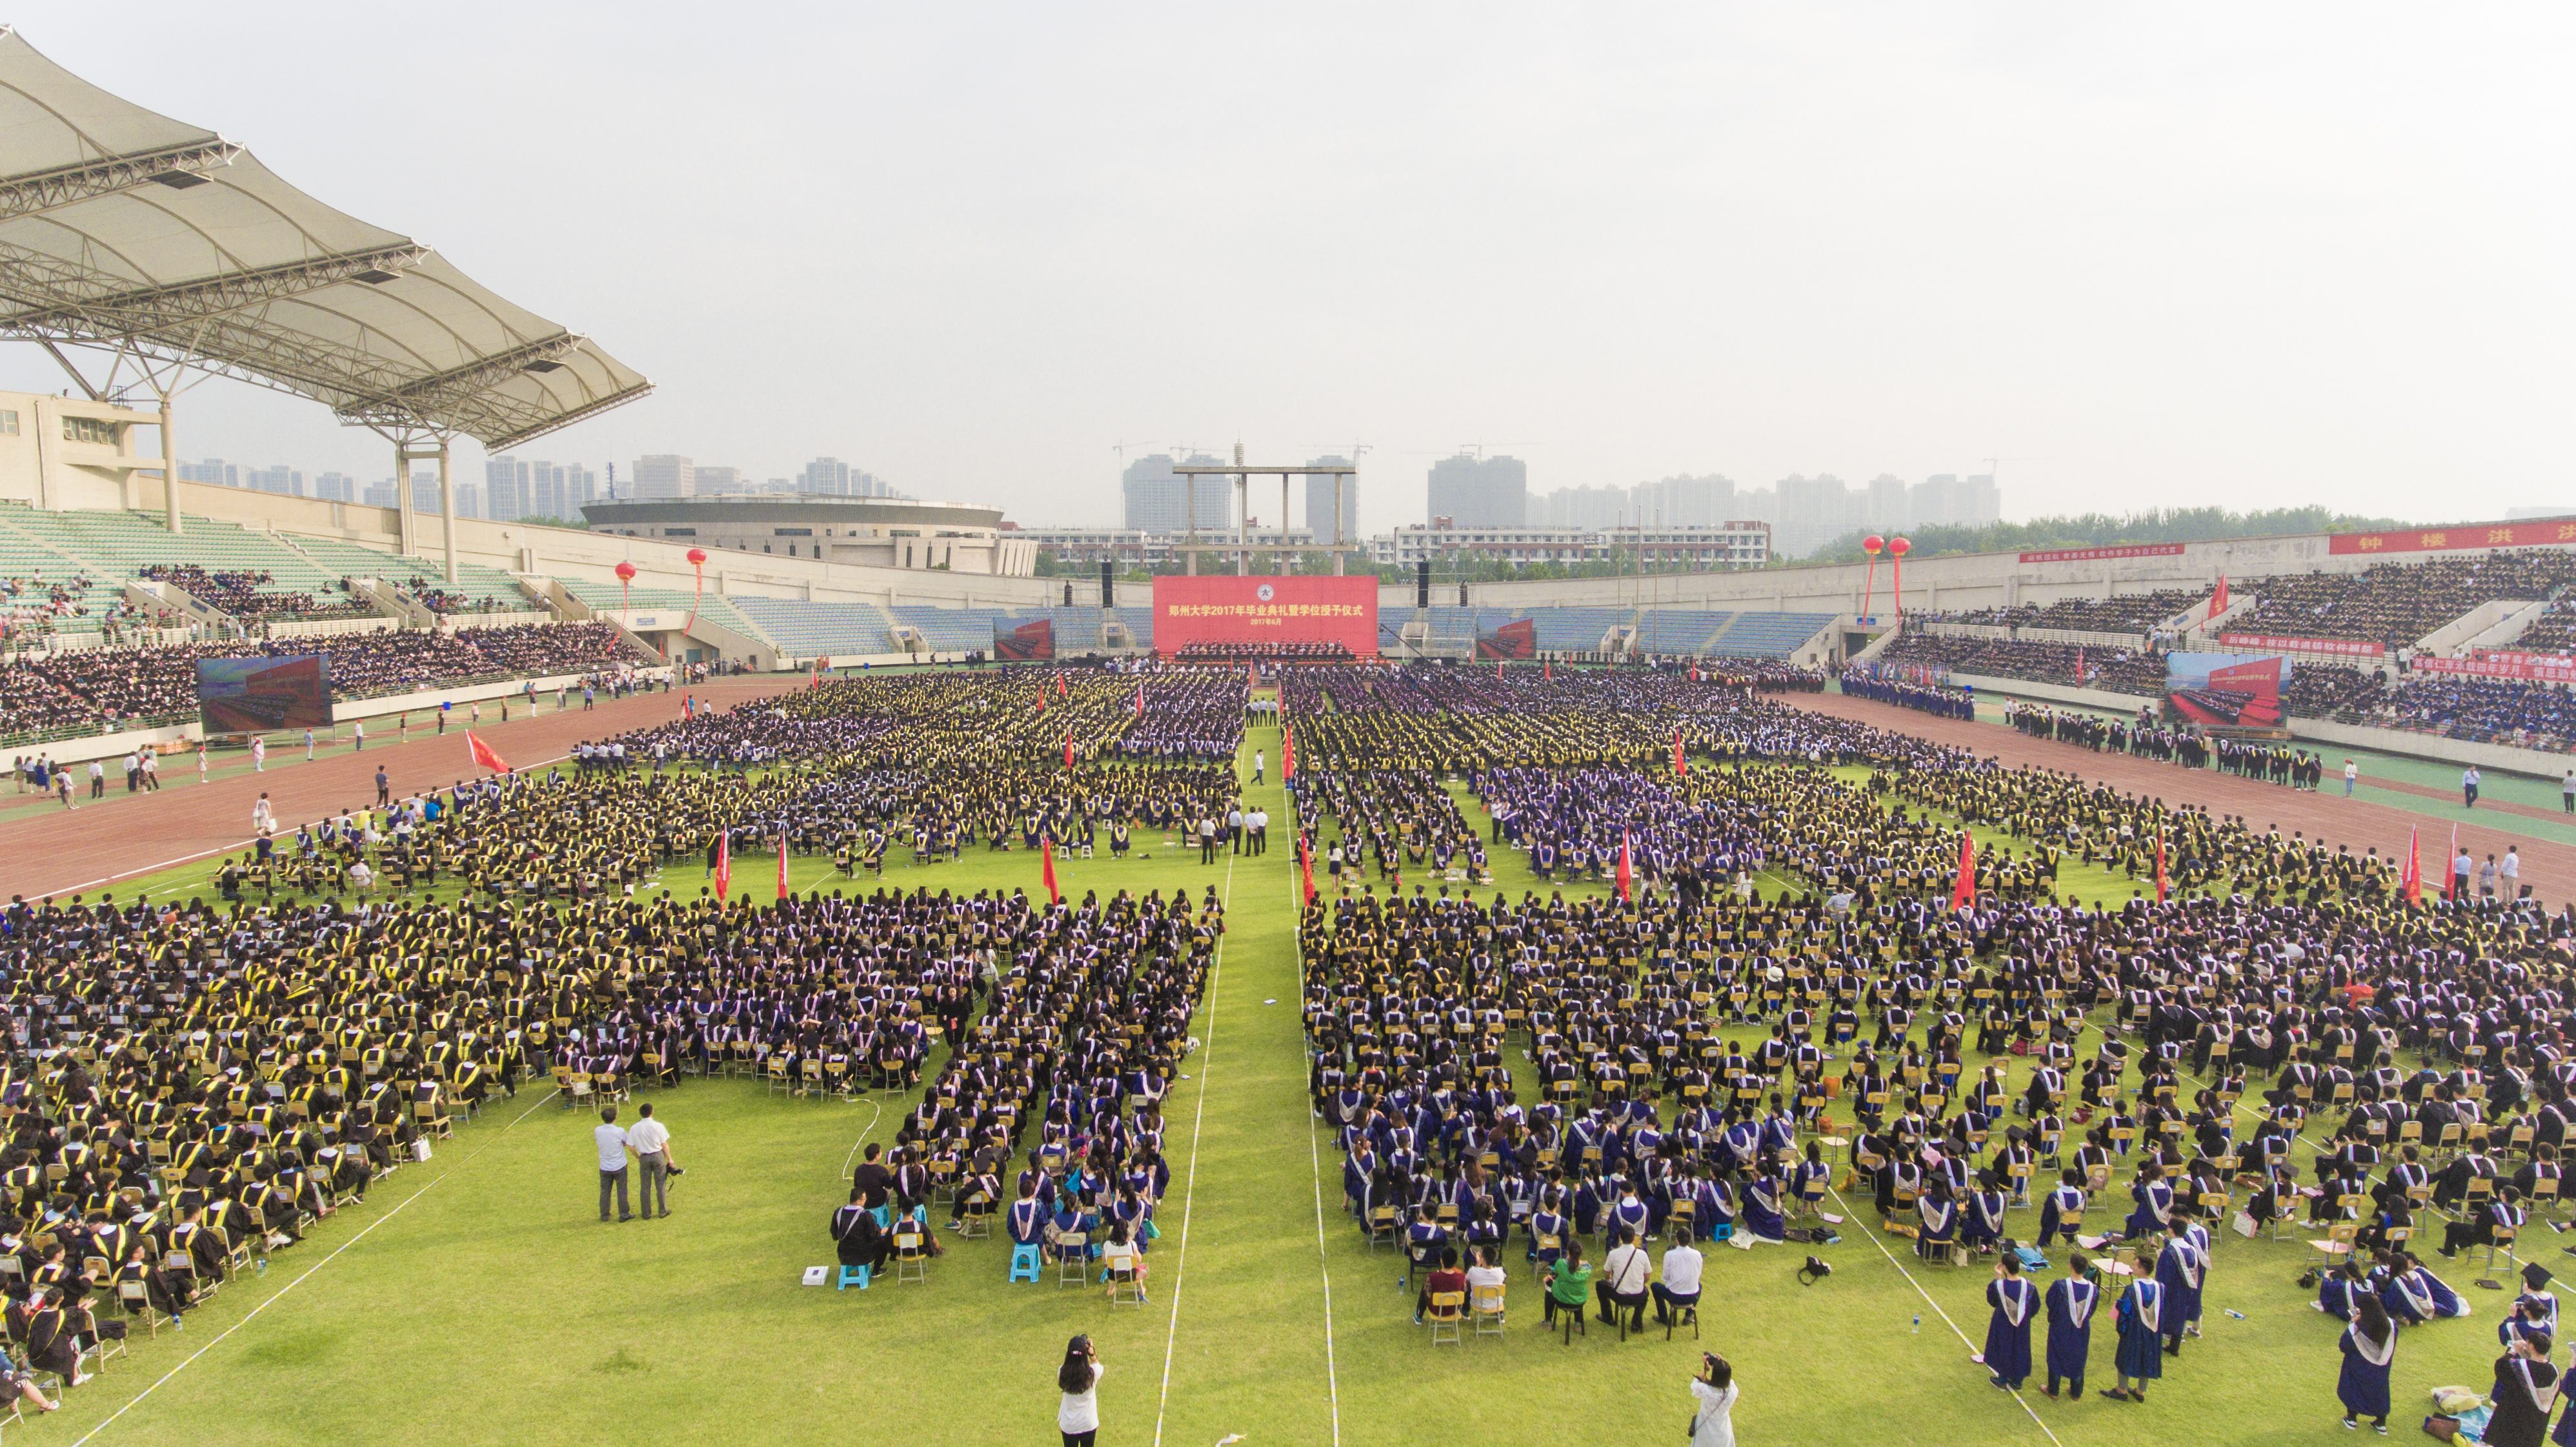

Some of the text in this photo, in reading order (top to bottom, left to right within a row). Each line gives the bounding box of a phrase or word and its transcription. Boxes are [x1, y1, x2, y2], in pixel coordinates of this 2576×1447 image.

[2098, 547, 2177, 557] 软件学子为自己代言
[1169, 605, 1363, 616] 郑州大学2017年毕业典礼暨学位授予仪式
